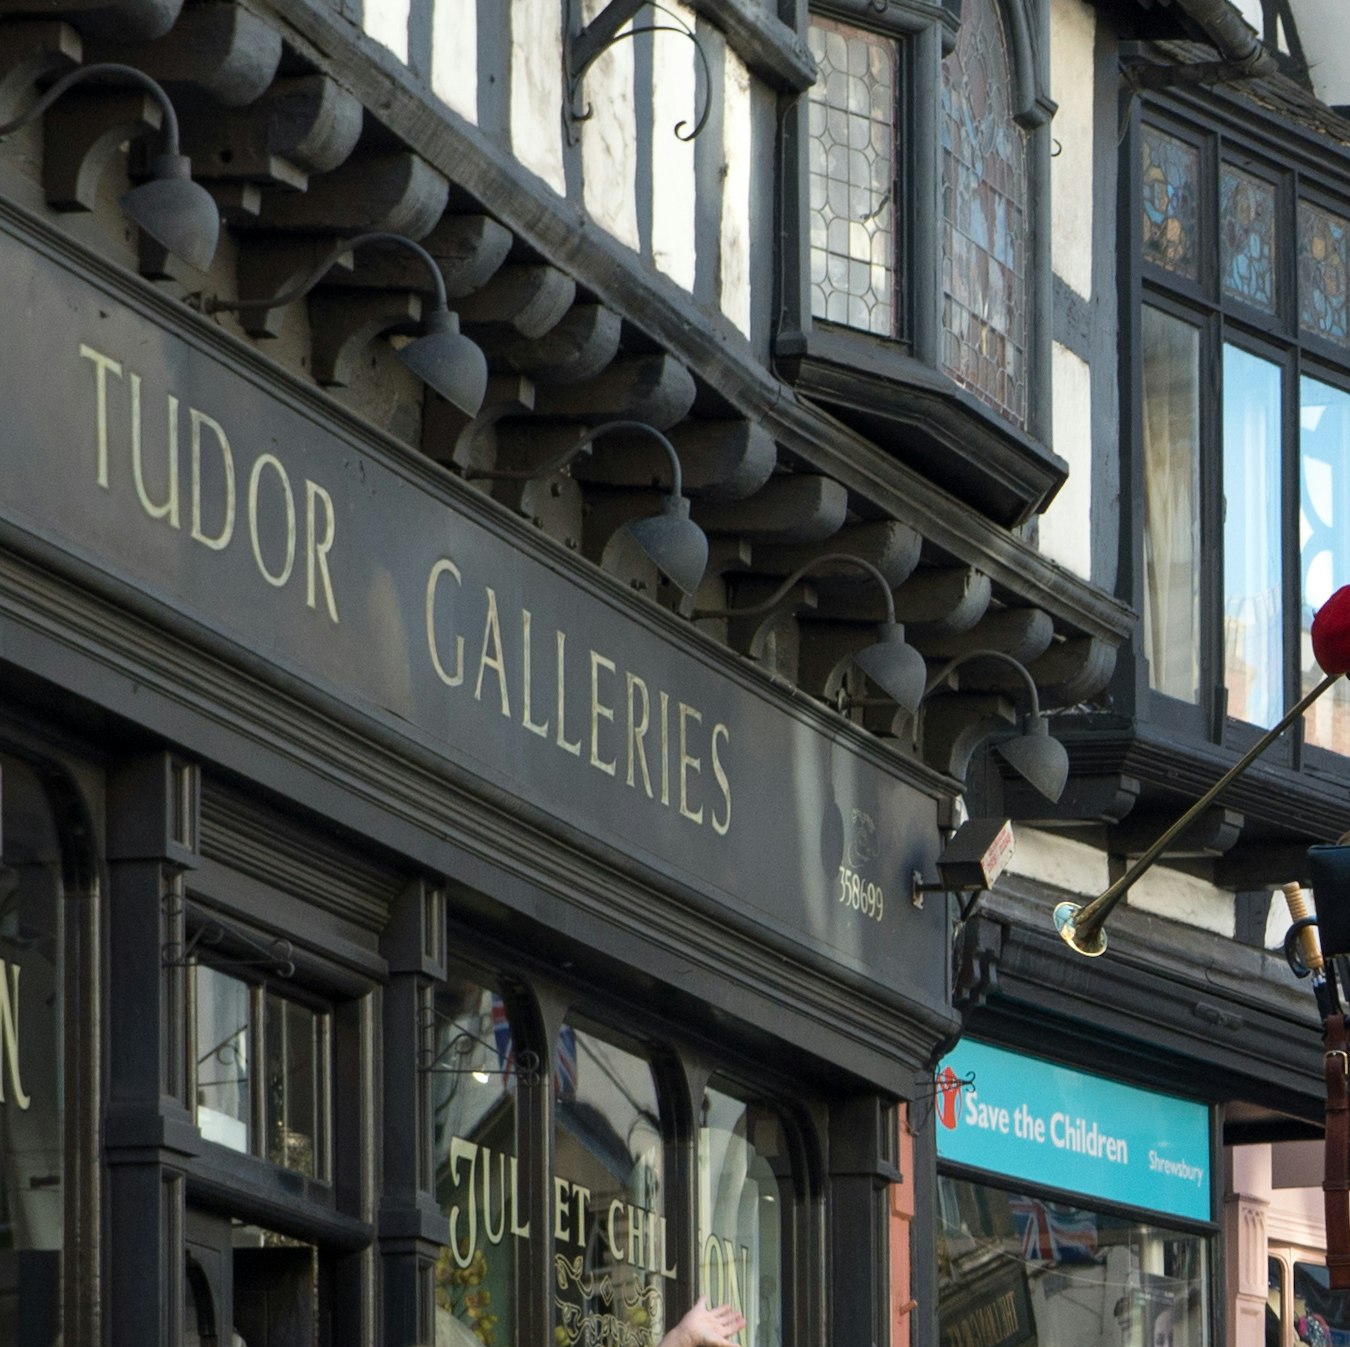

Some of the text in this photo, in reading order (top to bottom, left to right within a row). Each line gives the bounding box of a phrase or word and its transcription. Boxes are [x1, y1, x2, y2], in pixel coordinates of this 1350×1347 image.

[78, 343, 734, 836] TUDOR GALLERIES
[838, 865, 884, 923] 358699
[965, 1090, 1129, 1165] Save the Children
[449, 1135, 591, 1269] JULET
[1148, 1150, 1204, 1188] Shrewsbury
